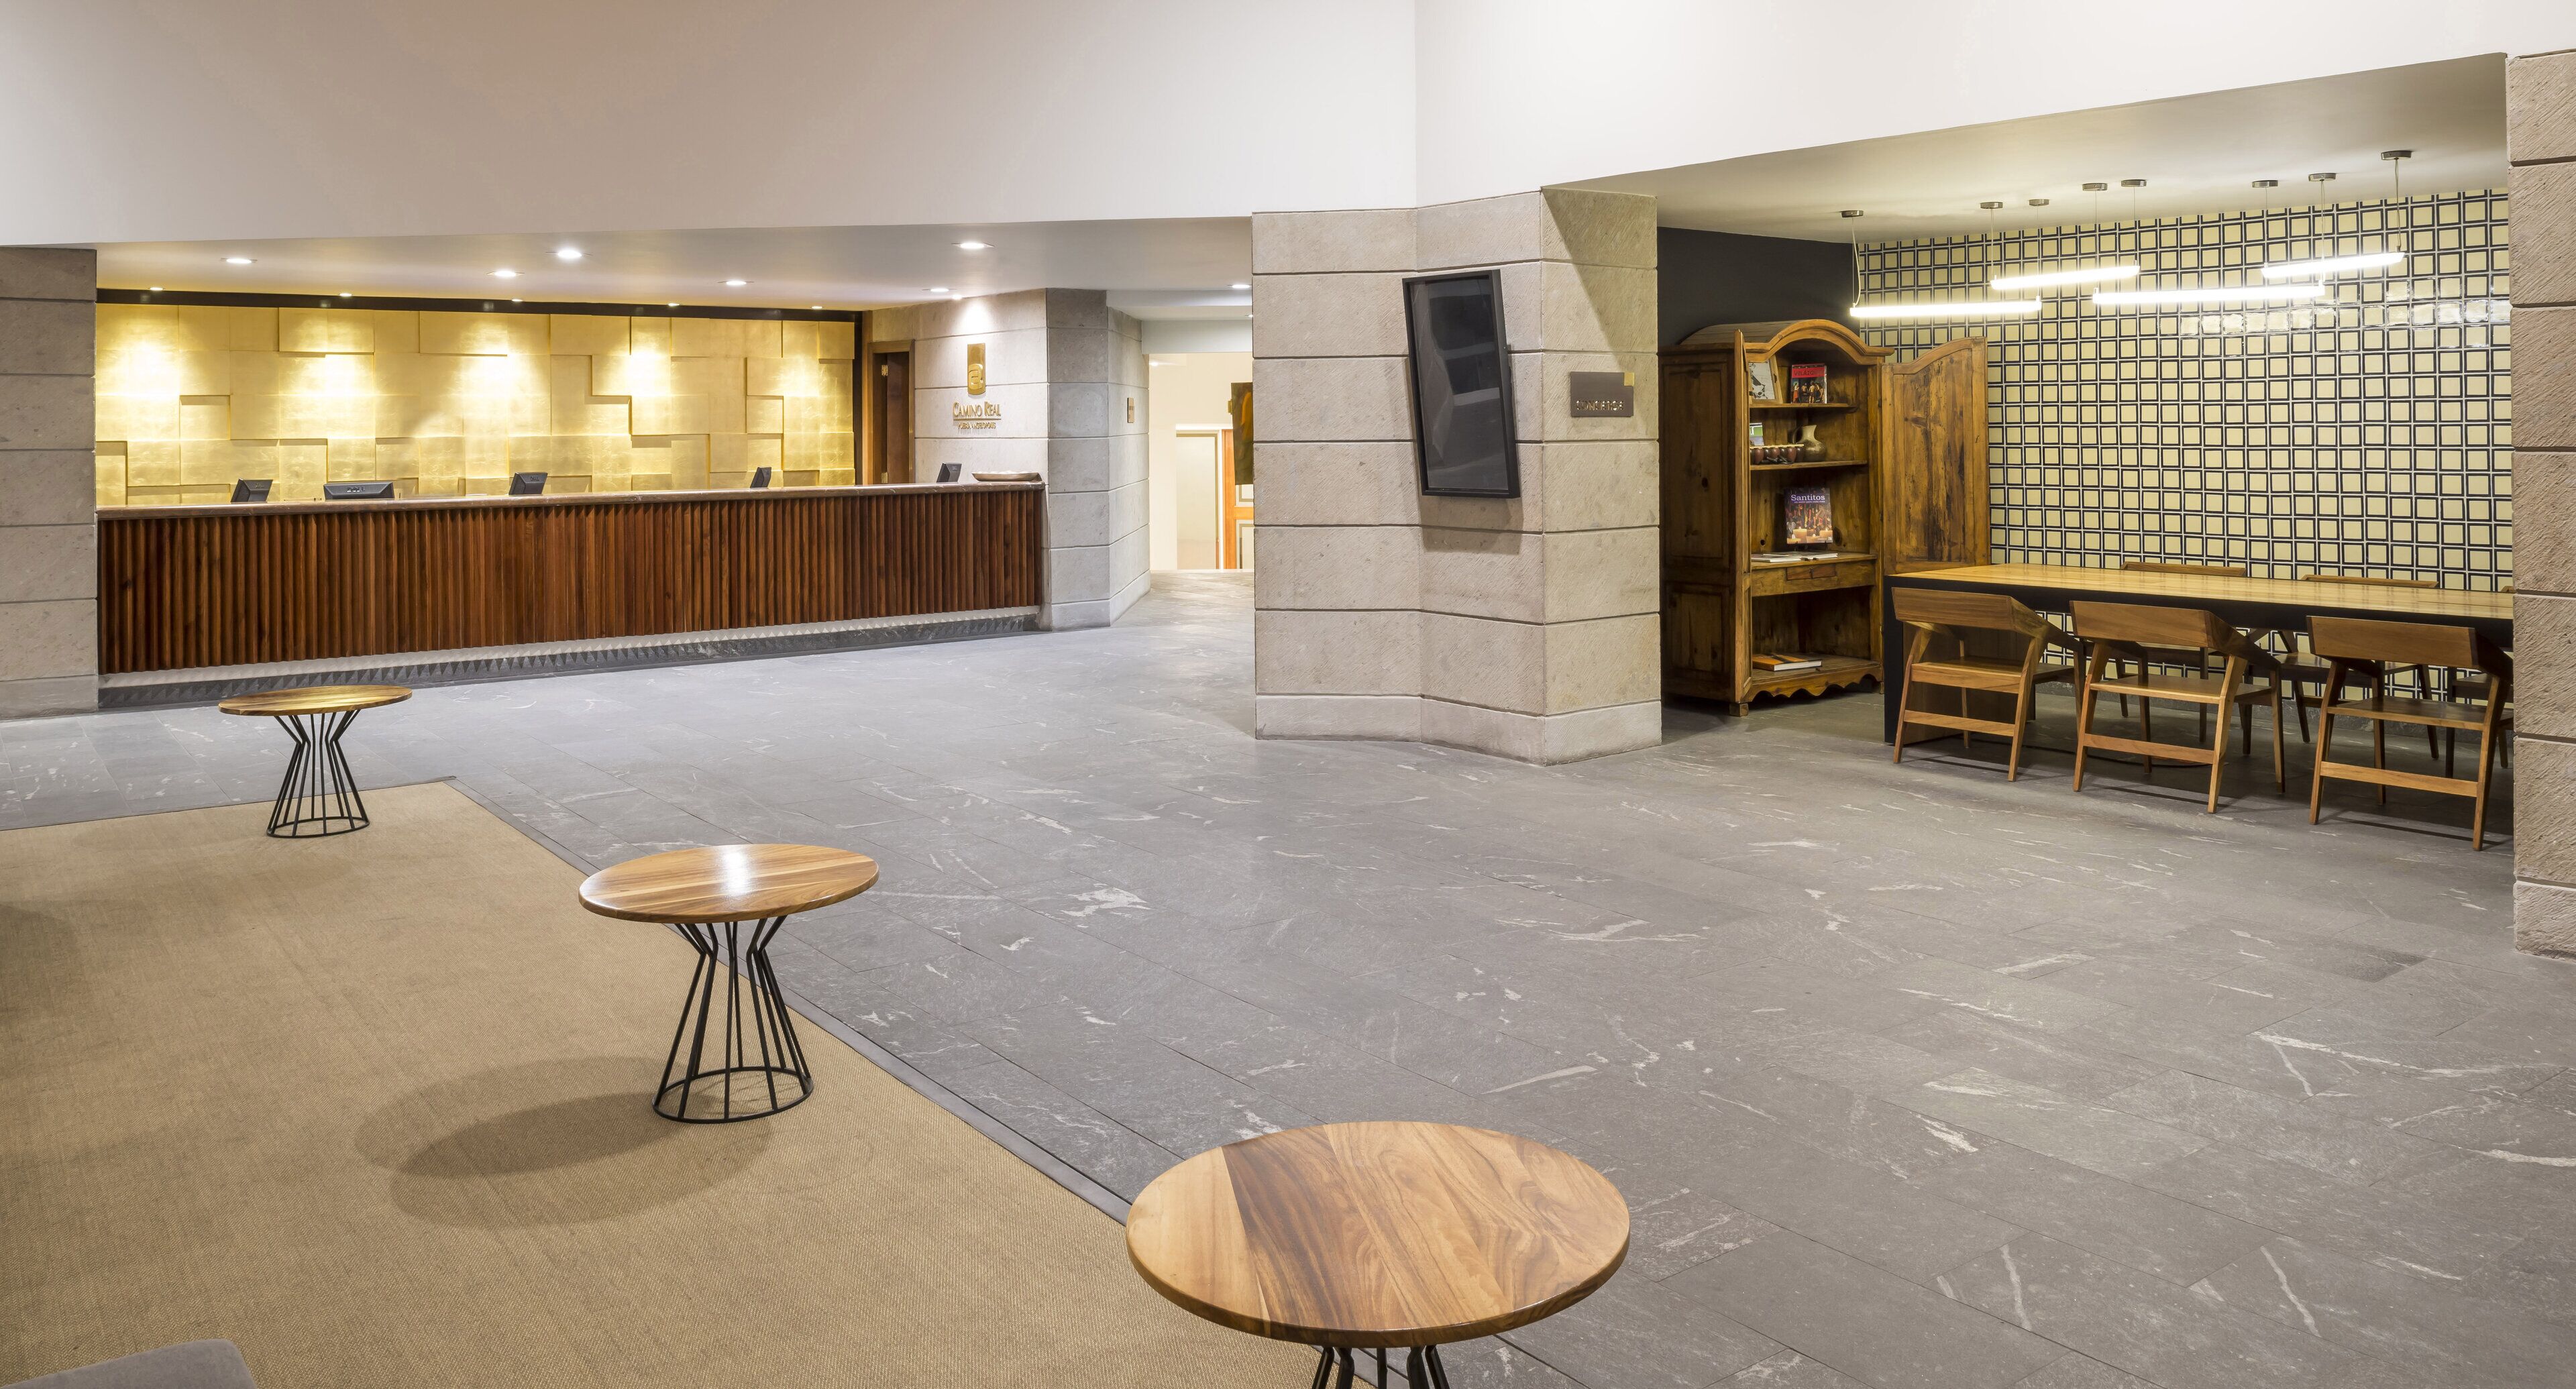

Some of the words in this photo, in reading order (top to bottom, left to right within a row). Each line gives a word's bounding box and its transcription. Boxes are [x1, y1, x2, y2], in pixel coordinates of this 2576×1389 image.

[953, 402, 983, 417] CAMINO
[984, 401, 1002, 416] REAL
[1576, 400, 1624, 411] CONCIERGE
